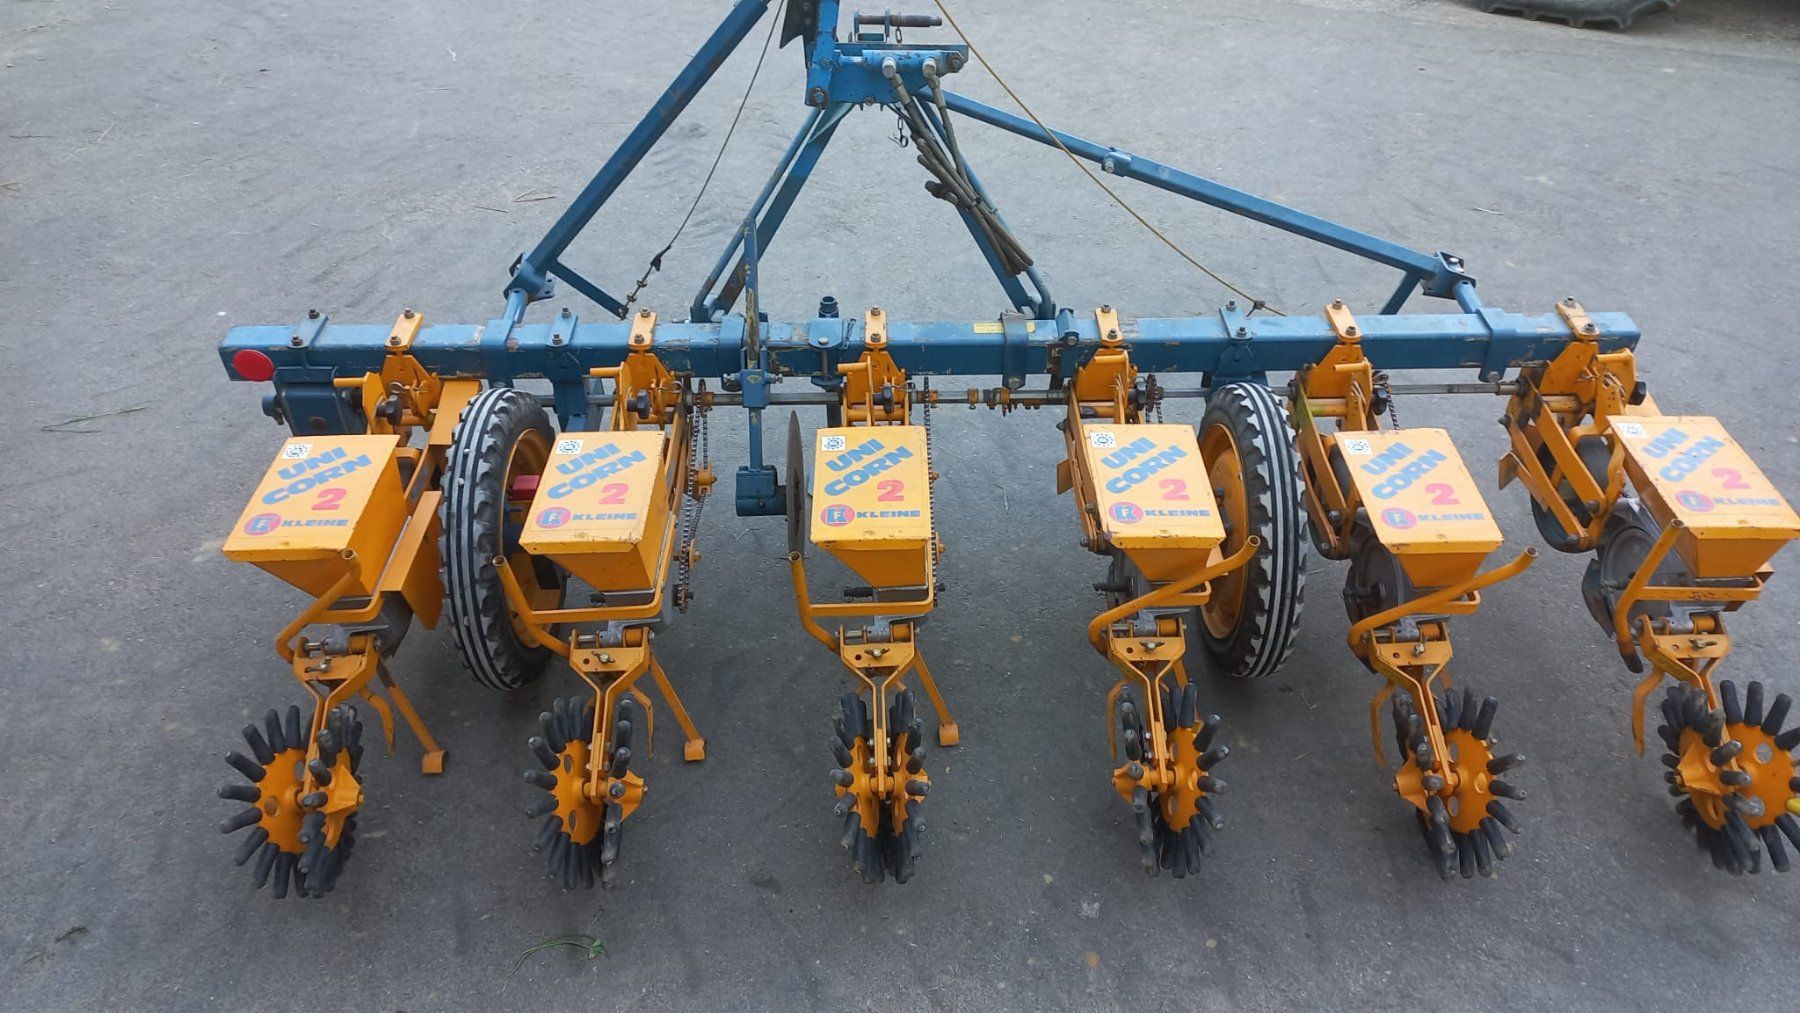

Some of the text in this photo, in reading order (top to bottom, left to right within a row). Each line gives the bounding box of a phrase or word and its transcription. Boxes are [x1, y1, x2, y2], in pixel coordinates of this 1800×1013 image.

[278, 447, 347, 480] UNI
[556, 443, 621, 475] UNI
[825, 438, 885, 471] UNI
[1101, 437, 1157, 469] UNI
[1360, 442, 1415, 475] UNI
[262, 454, 372, 505] CORN
[547, 450, 647, 499] CORN
[824, 445, 914, 496] CORN
[1105, 444, 1189, 494] CORN
[1371, 449, 1448, 499] CORN
[1712, 468, 1751, 490] 2
[311, 488, 347, 511] 2
[598, 483, 629, 505] 2
[877, 480, 905, 502] 2
[1159, 479, 1190, 501] 2
[1425, 483, 1460, 506] 2
[281, 519, 349, 527] KLEINE
[572, 512, 638, 521] KLEINE
[856, 510, 921, 518] KLEINE
[1145, 509, 1211, 517] KLEINE
[1418, 513, 1486, 521] KLEINE
